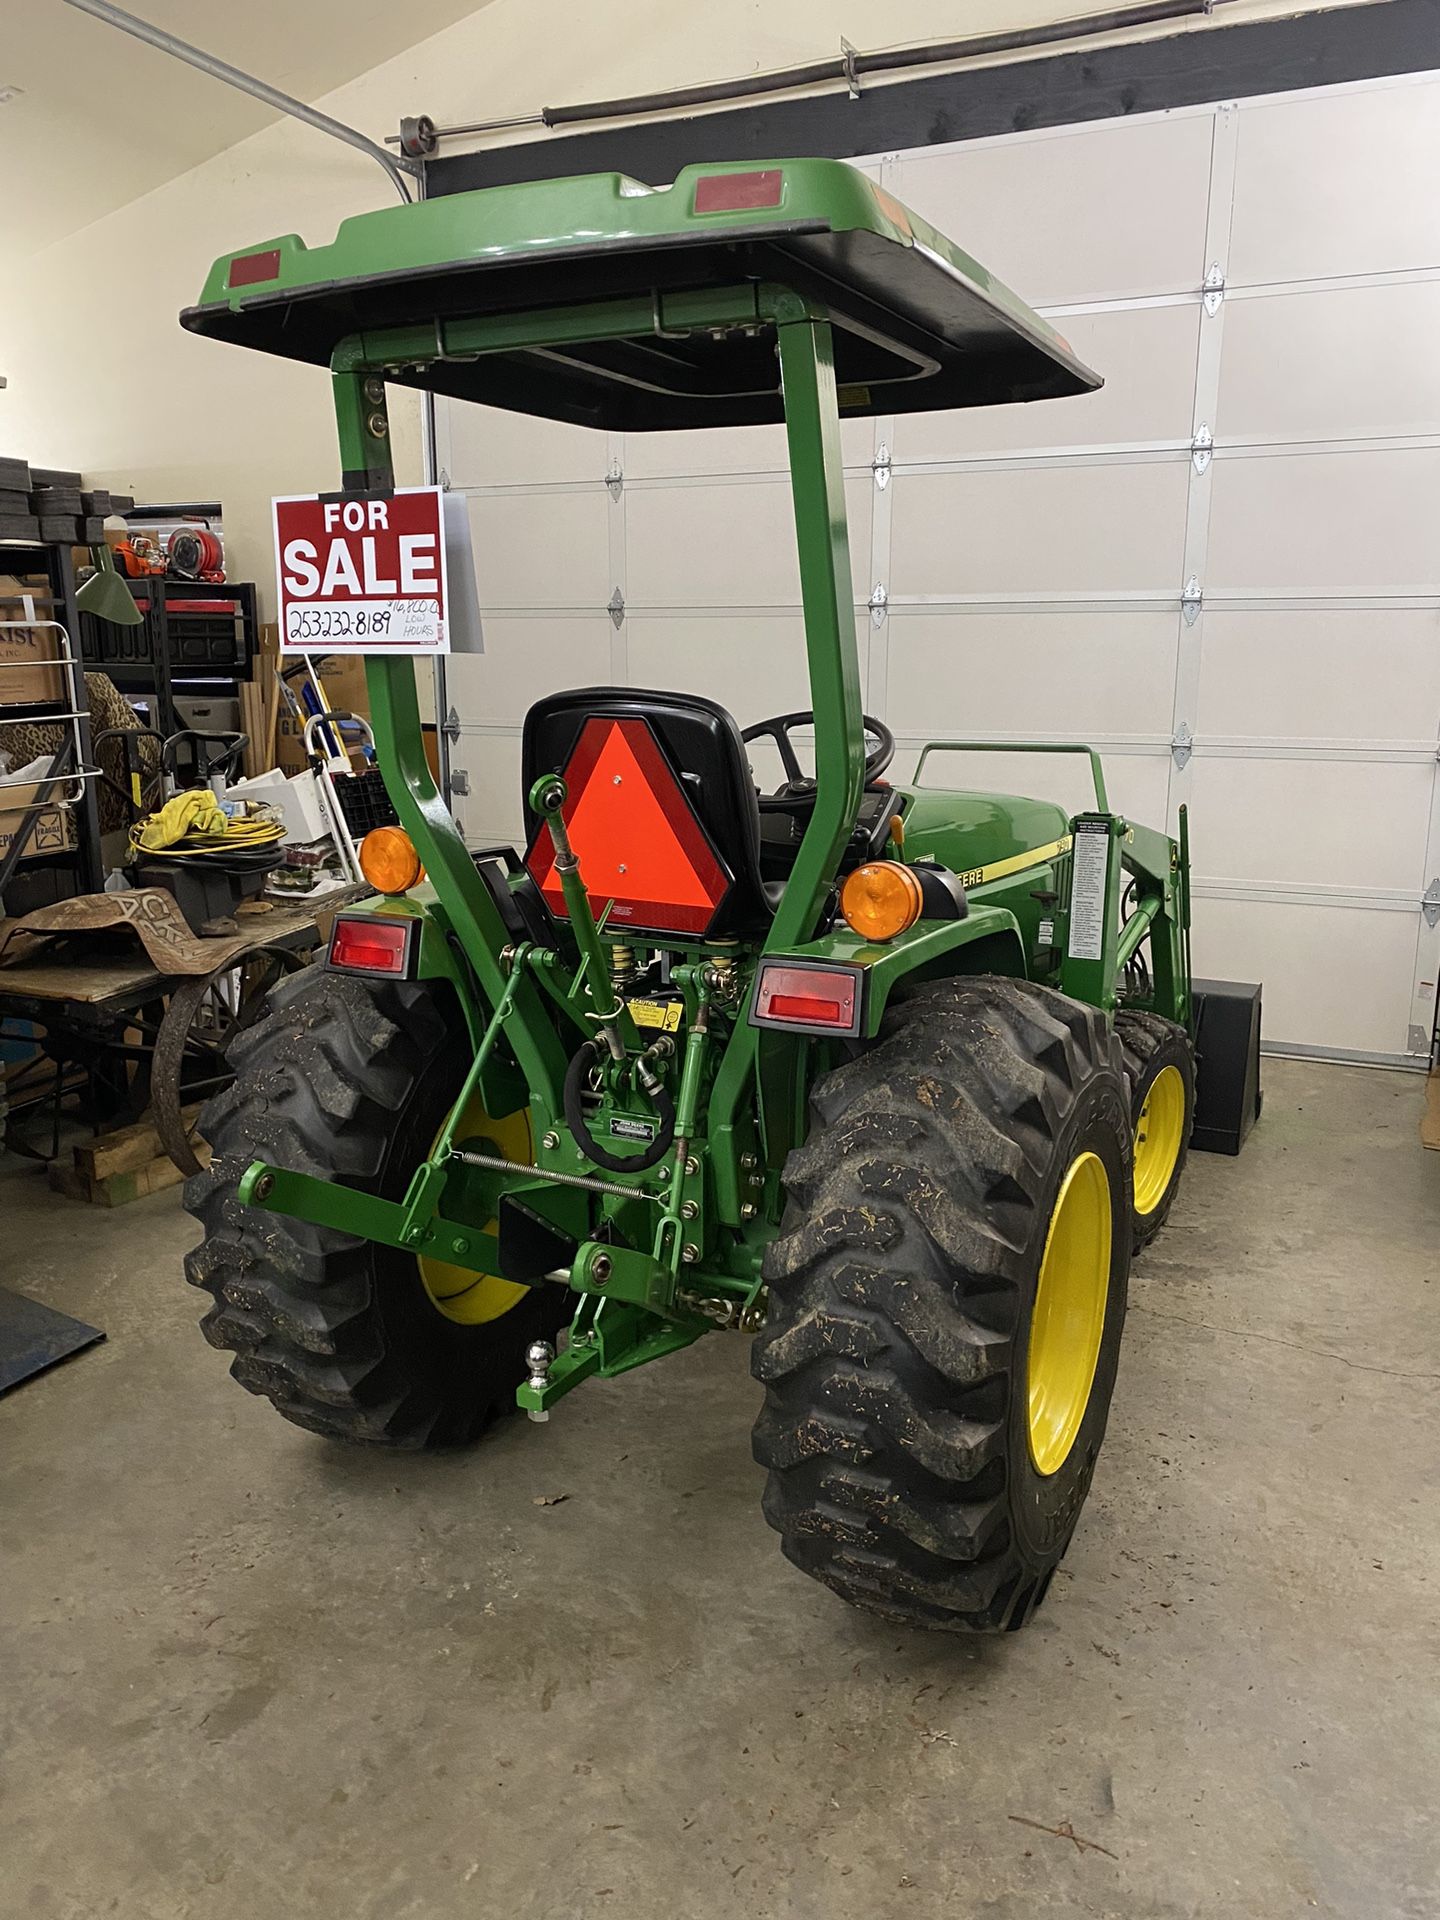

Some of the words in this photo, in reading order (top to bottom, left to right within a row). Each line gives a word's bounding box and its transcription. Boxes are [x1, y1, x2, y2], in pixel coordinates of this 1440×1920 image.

[324, 501, 389, 533] FOR
[284, 533, 438, 597] SALE
[290, 610, 391, 639] 253-232-8189
[402, 625, 433, 637] HOURS
[405, 613, 425, 624] LOW
